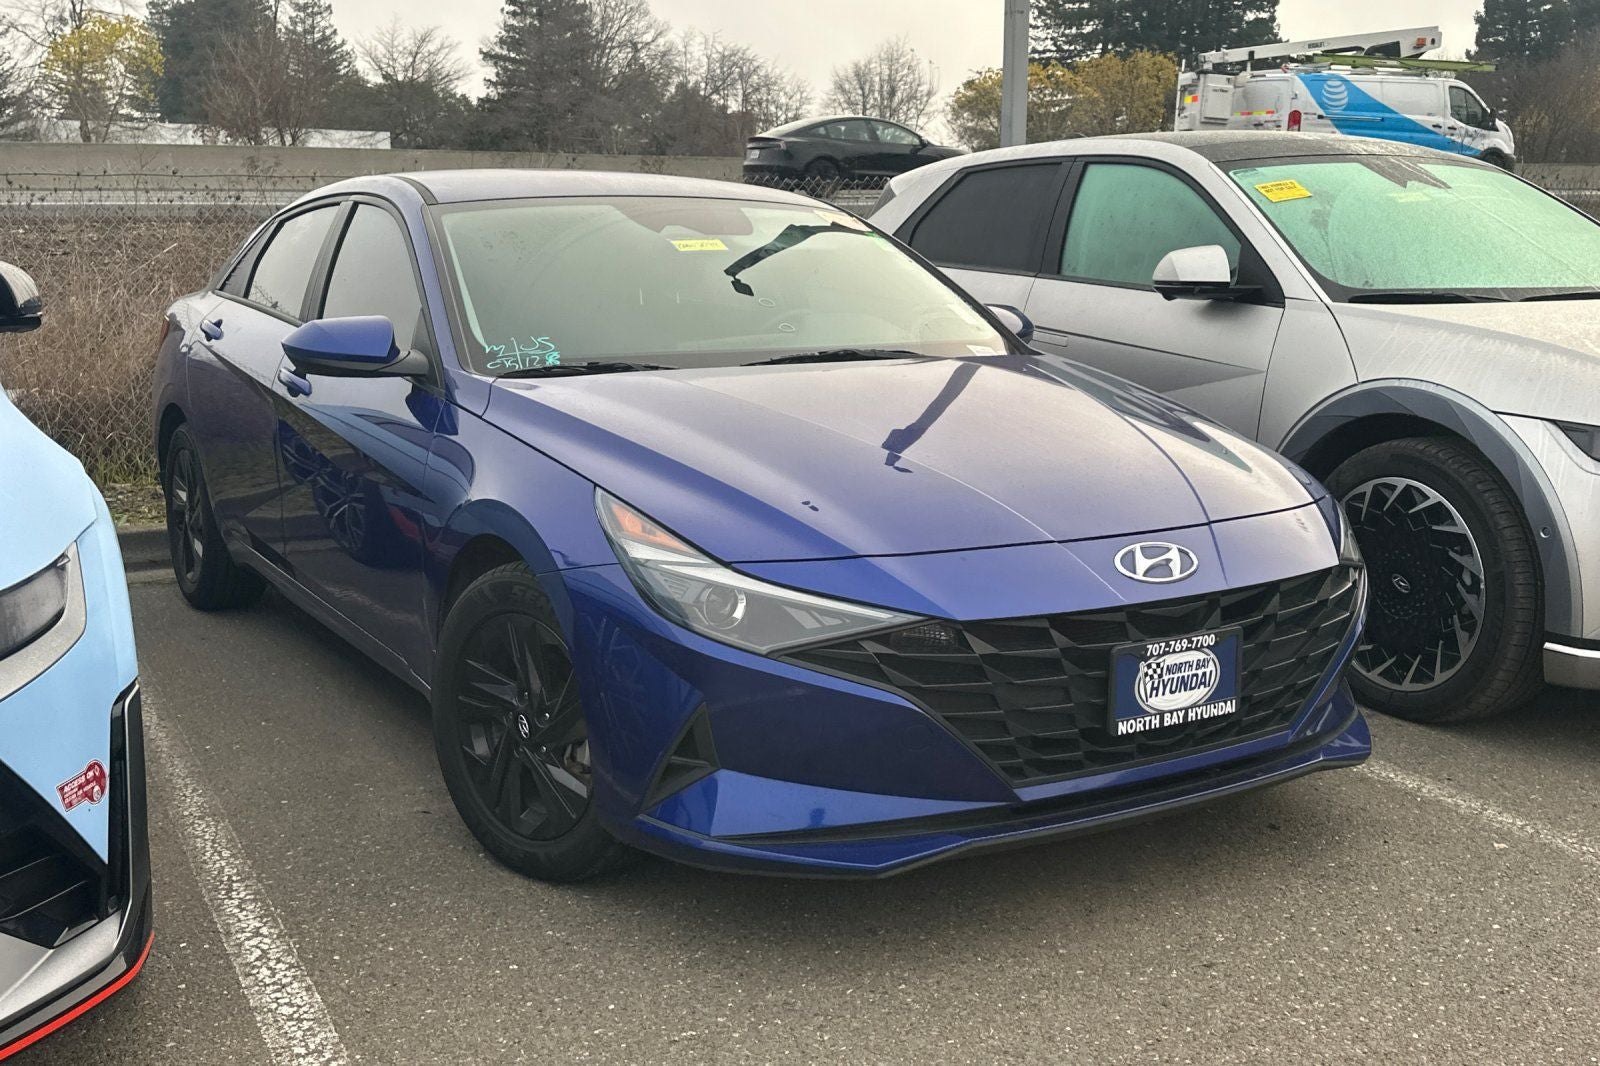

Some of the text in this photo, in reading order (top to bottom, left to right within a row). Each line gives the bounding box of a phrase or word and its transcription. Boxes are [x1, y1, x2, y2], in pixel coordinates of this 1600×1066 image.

[1146, 634, 1215, 656] 707-769-7700
[1165, 657, 1212, 676] NORTH BAY
[1149, 670, 1213, 698] HYUNDAI
[1117, 699, 1236, 736] NORTH BAY HYUNDAI
[63, 774, 86, 793] ACCESS
